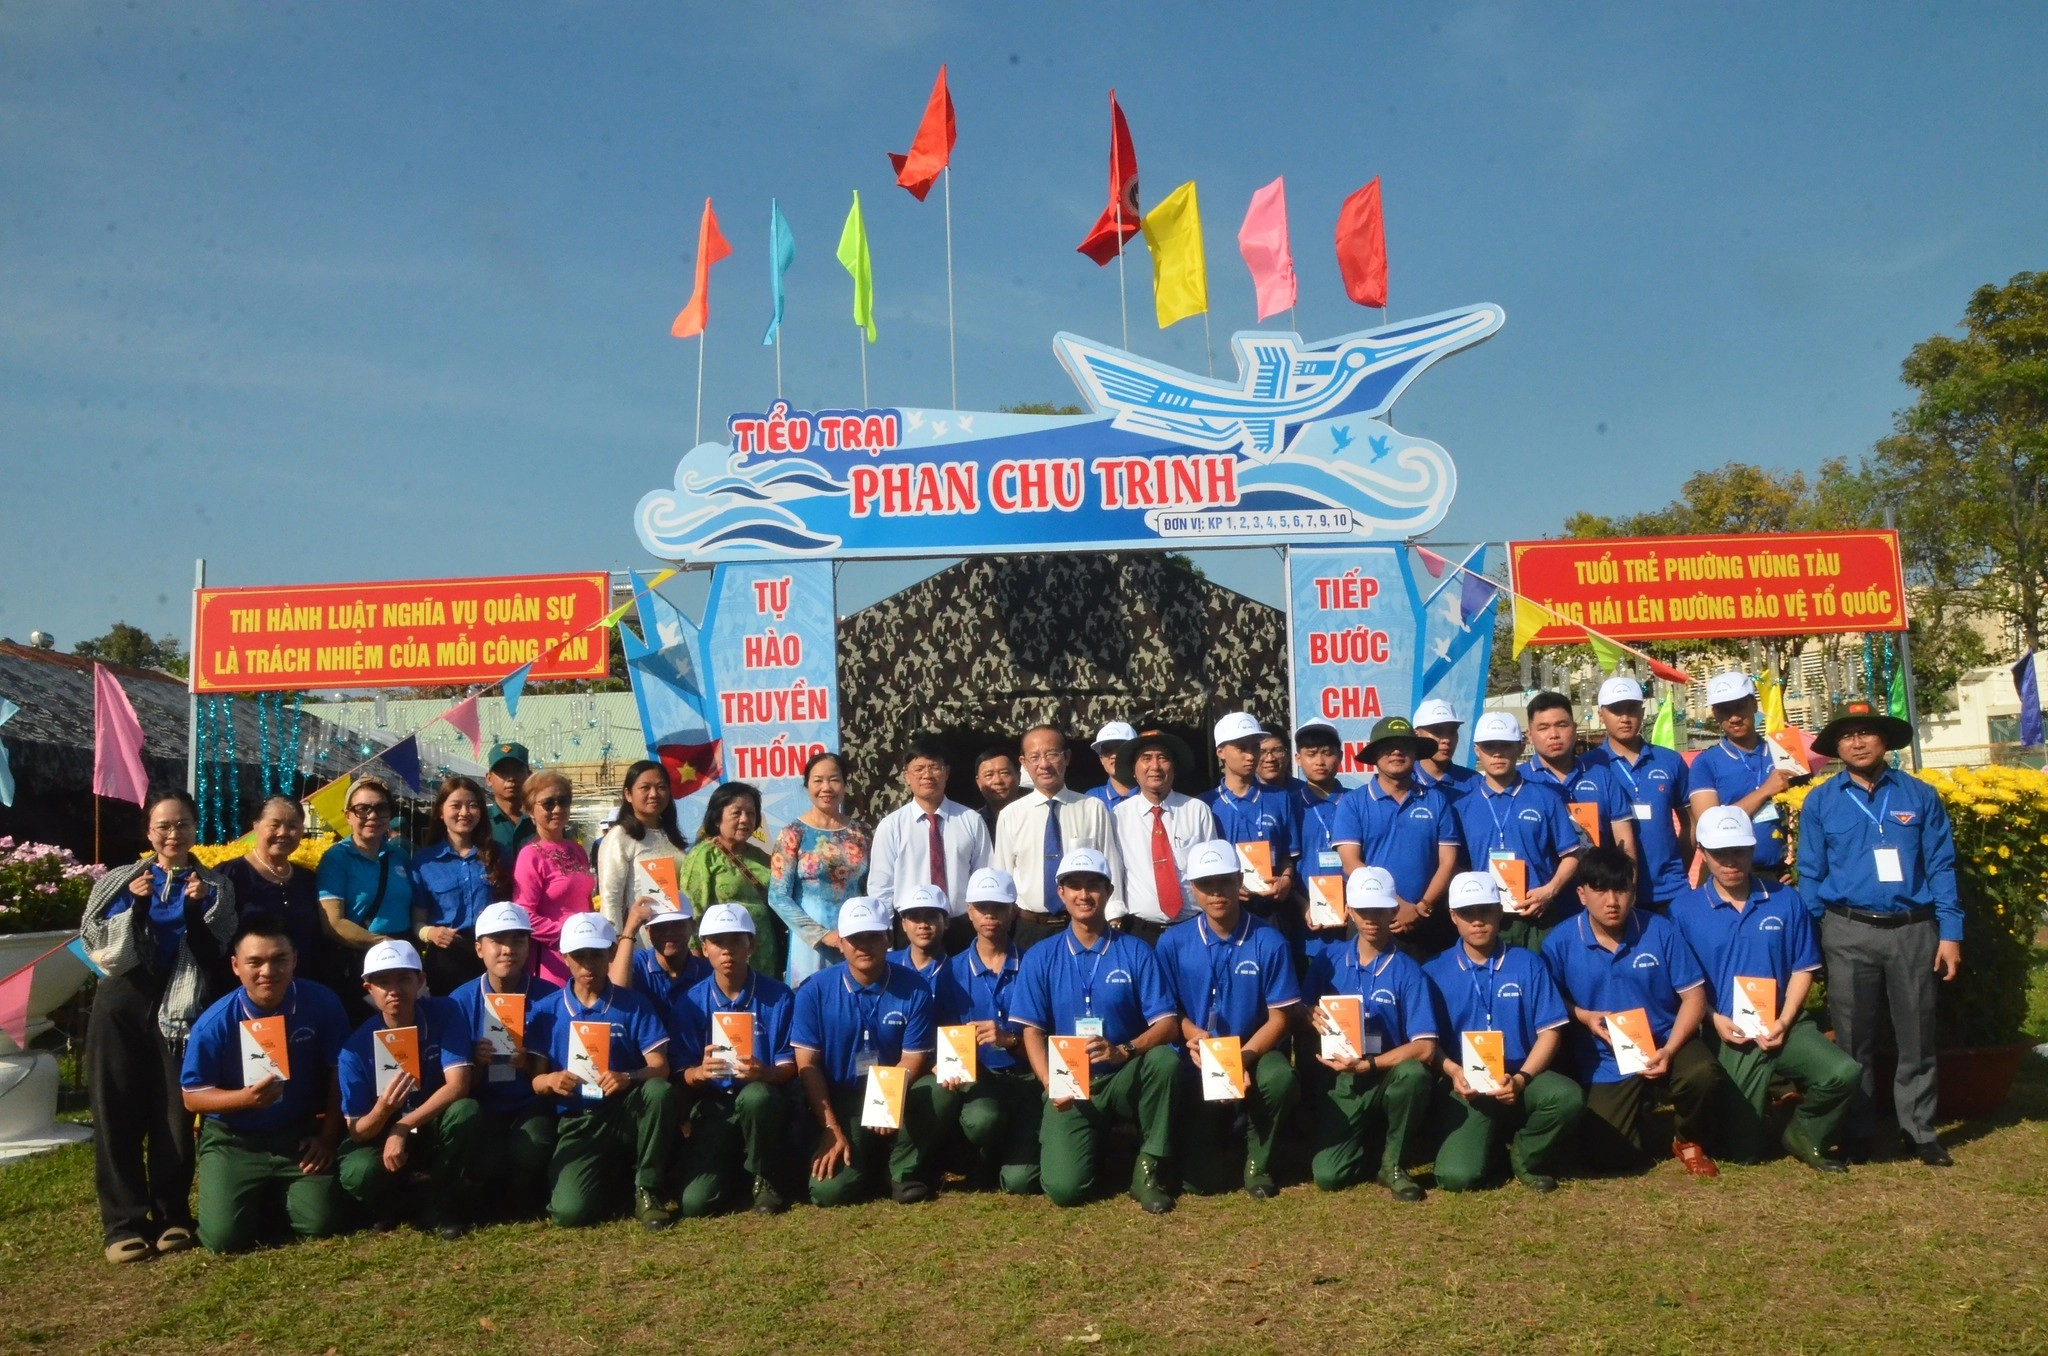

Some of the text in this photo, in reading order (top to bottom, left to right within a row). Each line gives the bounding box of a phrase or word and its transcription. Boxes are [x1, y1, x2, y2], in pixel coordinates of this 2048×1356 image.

[732, 403, 896, 455] TIỂU TRẠI
[849, 456, 1239, 515] PHAN CHU TRINH
[1164, 517, 1187, 531] ĐƠN
[1191, 517, 1204, 532] VỊ:
[1208, 517, 1223, 530] KP
[1239, 517, 1250, 530] 2,
[1253, 516, 1263, 529] 3,
[1266, 516, 1277, 529] 4,
[1280, 515, 1290, 528] 5,
[1293, 515, 1303, 528] 6,
[1306, 514, 1317, 528] 7,
[1319, 514, 1330, 527] 9,
[1333, 514, 1347, 526] 10
[1574, 548, 1840, 585] TUỔI TRẺ PHƯỜNG VŨNG TÀU
[754, 577, 790, 619] TỰ
[1315, 568, 1378, 609] TIẾP
[1544, 583, 1892, 627] ĂNG HÁI LÊN ĐƯỜNG BẢO VỆ TỔ QUỐC
[230, 593, 576, 634] THI HÀNH LUẬT NGHĨA VỤ QUÂN SỰ
[215, 646, 239, 675] LÀ
[245, 644, 310, 674] TRÁCH
[317, 641, 383, 675] NHIỆM
[390, 636, 431, 668] CỦA
[437, 633, 476, 666] MỖI
[483, 635, 538, 665] CÔNG
[745, 630, 800, 668] HÀO
[1310, 626, 1388, 664] BƯỚC
[721, 680, 827, 723] TRUYỀN
[1322, 687, 1381, 718] CHA
